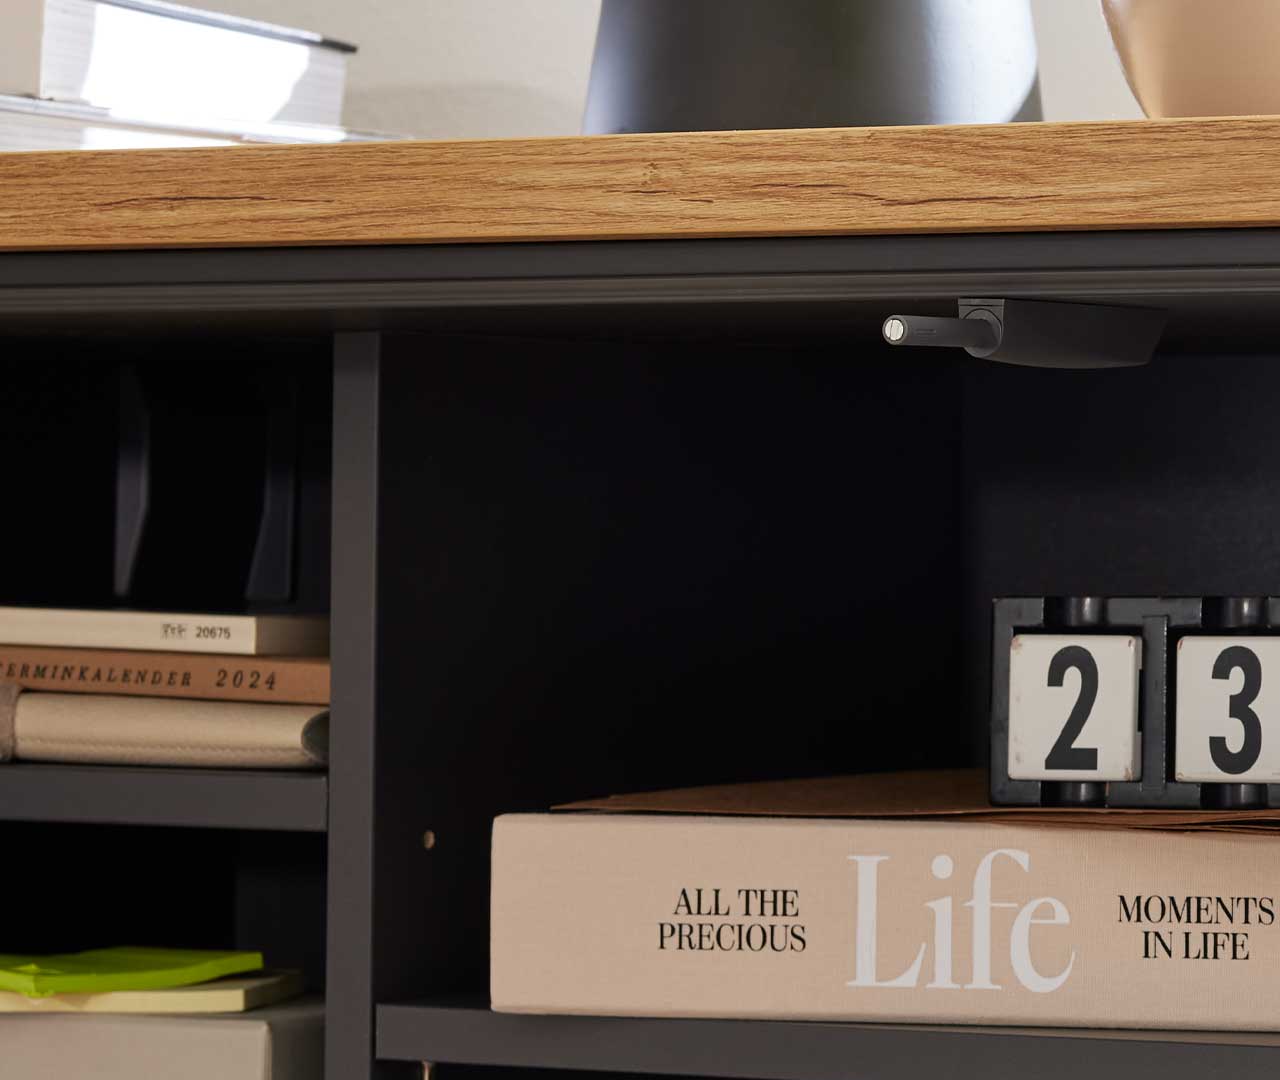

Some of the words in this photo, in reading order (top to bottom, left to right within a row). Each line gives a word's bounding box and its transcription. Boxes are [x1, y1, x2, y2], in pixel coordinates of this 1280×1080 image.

[195, 625, 231, 639] 20675
[215, 669, 278, 691] 2024
[1044, 645, 1099, 770] 2
[1208, 645, 1262, 774] 3
[673, 887, 731, 917] ALL
[737, 888, 800, 918] THE
[1117, 894, 1275, 926] MOMENTS
[846, 848, 1076, 993] Life
[657, 922, 807, 952] PRECIOUS
[1142, 930, 1173, 960] IN
[1182, 931, 1250, 961] LIFE
